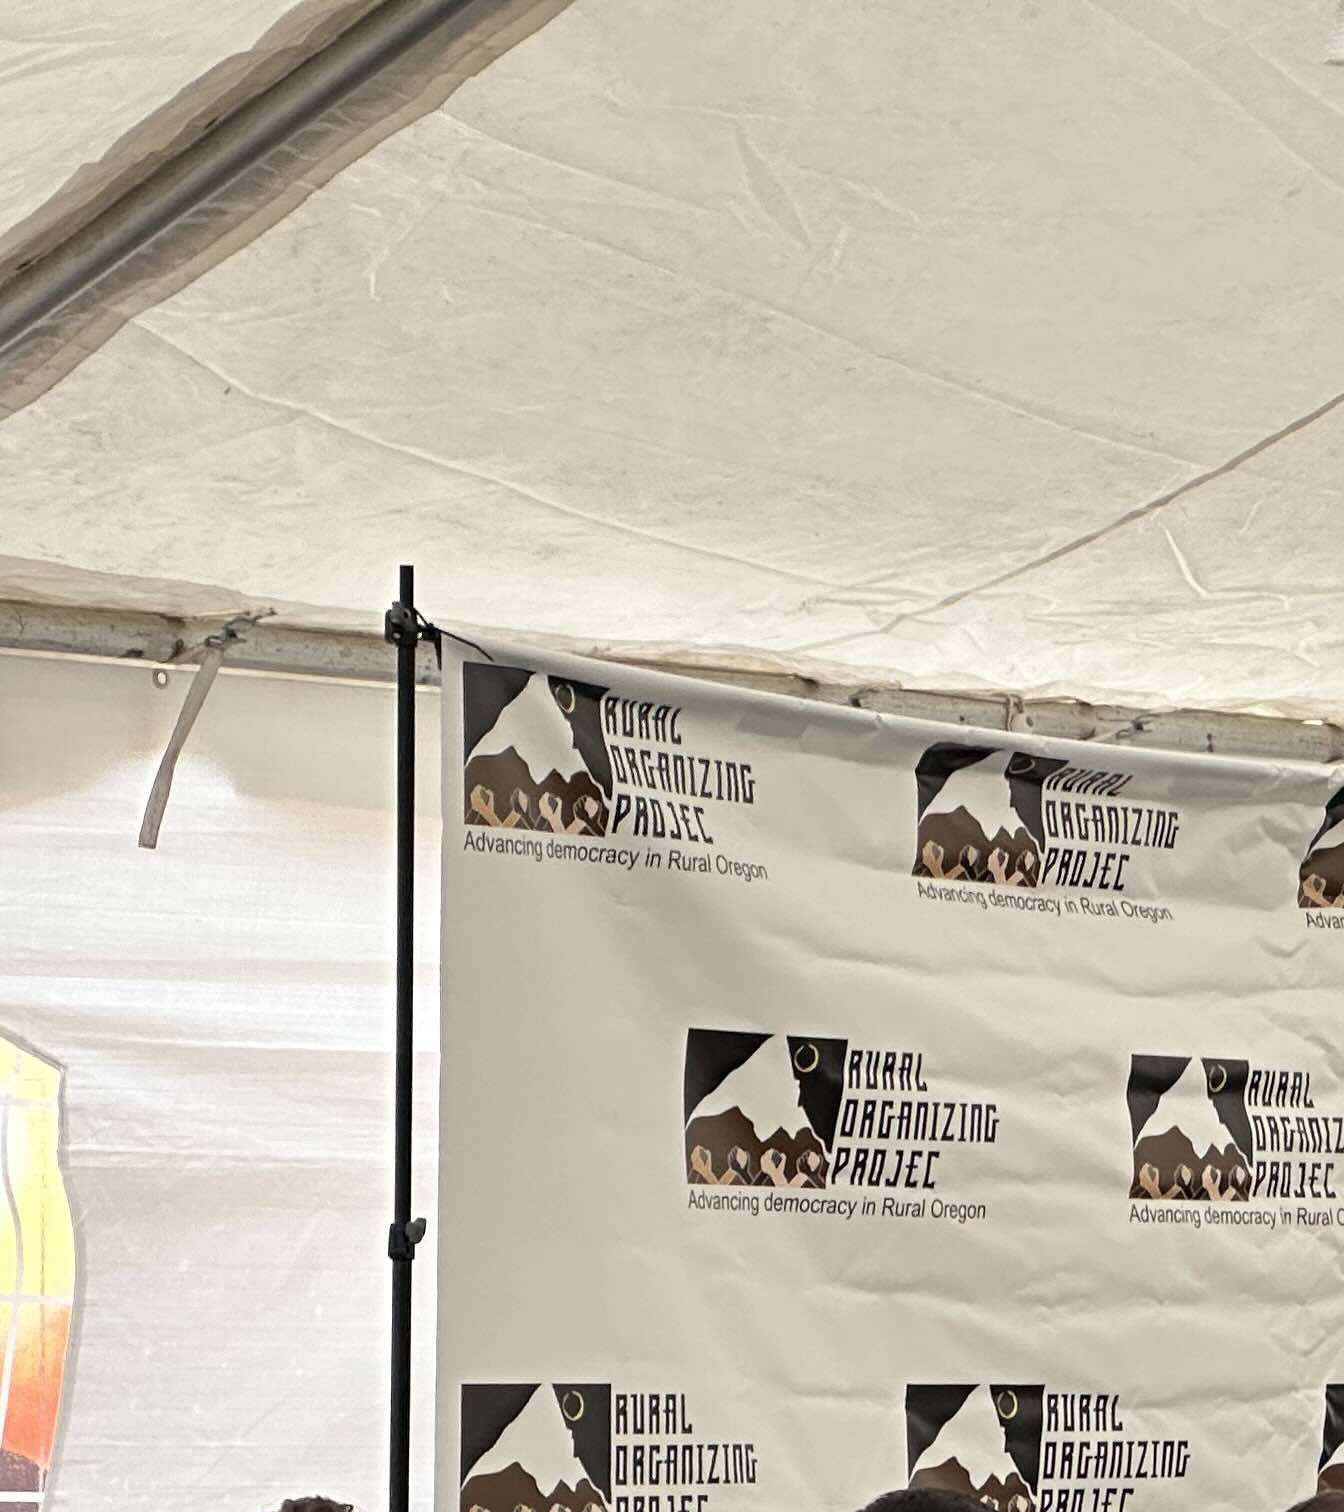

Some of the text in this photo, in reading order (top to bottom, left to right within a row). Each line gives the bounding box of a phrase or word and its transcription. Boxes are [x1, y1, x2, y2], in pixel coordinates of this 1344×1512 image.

[605, 697, 682, 744] RURAL
[610, 744, 756, 804] ORGANIZING
[1046, 767, 1133, 797] RURAL
[1046, 800, 1179, 849] ORGANIZING
[465, 831, 768, 882] Advancing democracy in Rural Oregon
[918, 882, 1173, 923] Advancing democracy in Rural Oregon
[848, 1050, 927, 1092] RURAL
[1249, 1070, 1314, 1108] RURAL
[840, 1099, 999, 1143] ORGANIZING
[688, 1190, 986, 1224] Advancing democracy in Rural Oregon
[1130, 1204, 1200, 1228] Advancing
[1205, 1206, 1276, 1229] democracy
[1280, 1208, 1291, 1223] in
[1297, 1208, 1333, 1226] Rural
[616, 1394, 692, 1434] RURAL
[1047, 1394, 1123, 1432] RURAL
[616, 1444, 757, 1485] ORGANIZING
[1042, 1440, 1190, 1479] ORGANIZING
